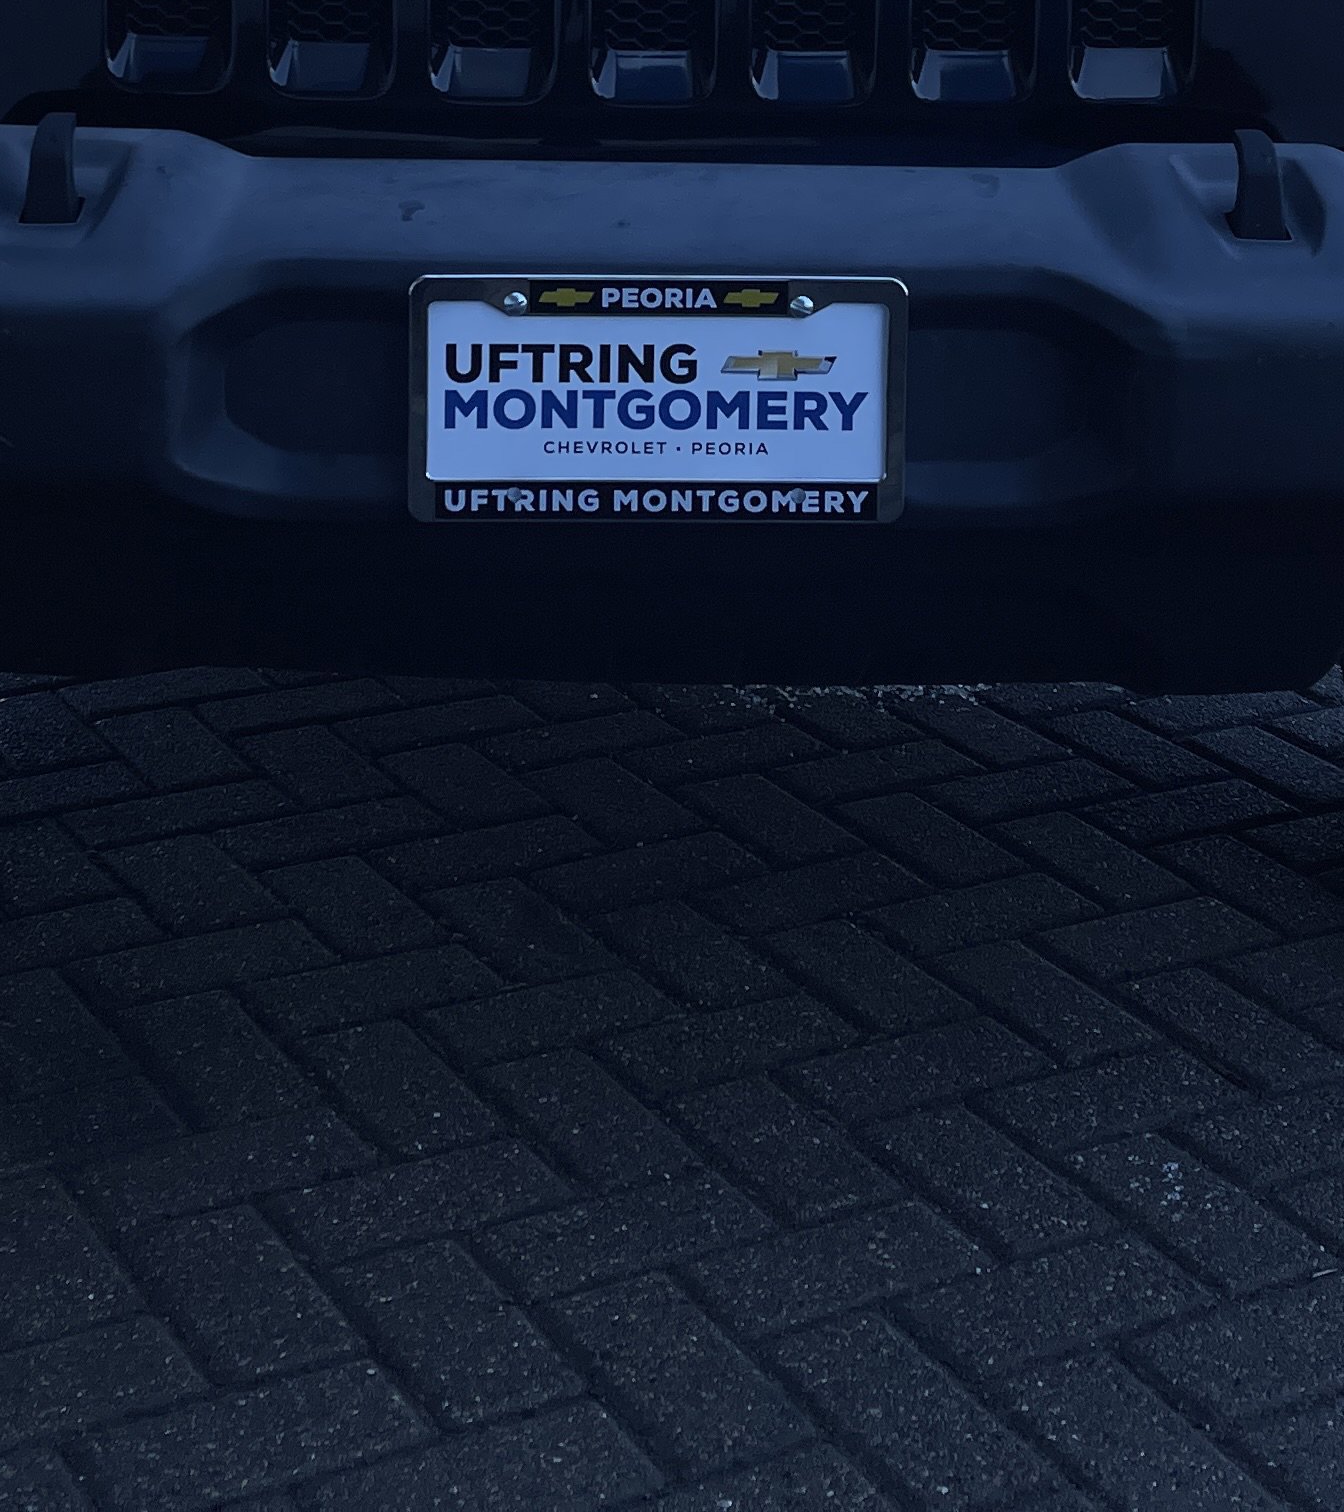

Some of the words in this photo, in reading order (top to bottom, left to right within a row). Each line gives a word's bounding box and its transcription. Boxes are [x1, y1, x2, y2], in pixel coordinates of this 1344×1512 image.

[601, 287, 718, 309] PEORIA
[445, 343, 698, 385] UFTRING
[443, 388, 869, 431] MONTGOMERY
[543, 440, 668, 455] CHEVROLET
[691, 442, 769, 456] PEORIA
[444, 488, 600, 513] UFTRING
[613, 489, 869, 514] MONTGOMERY
